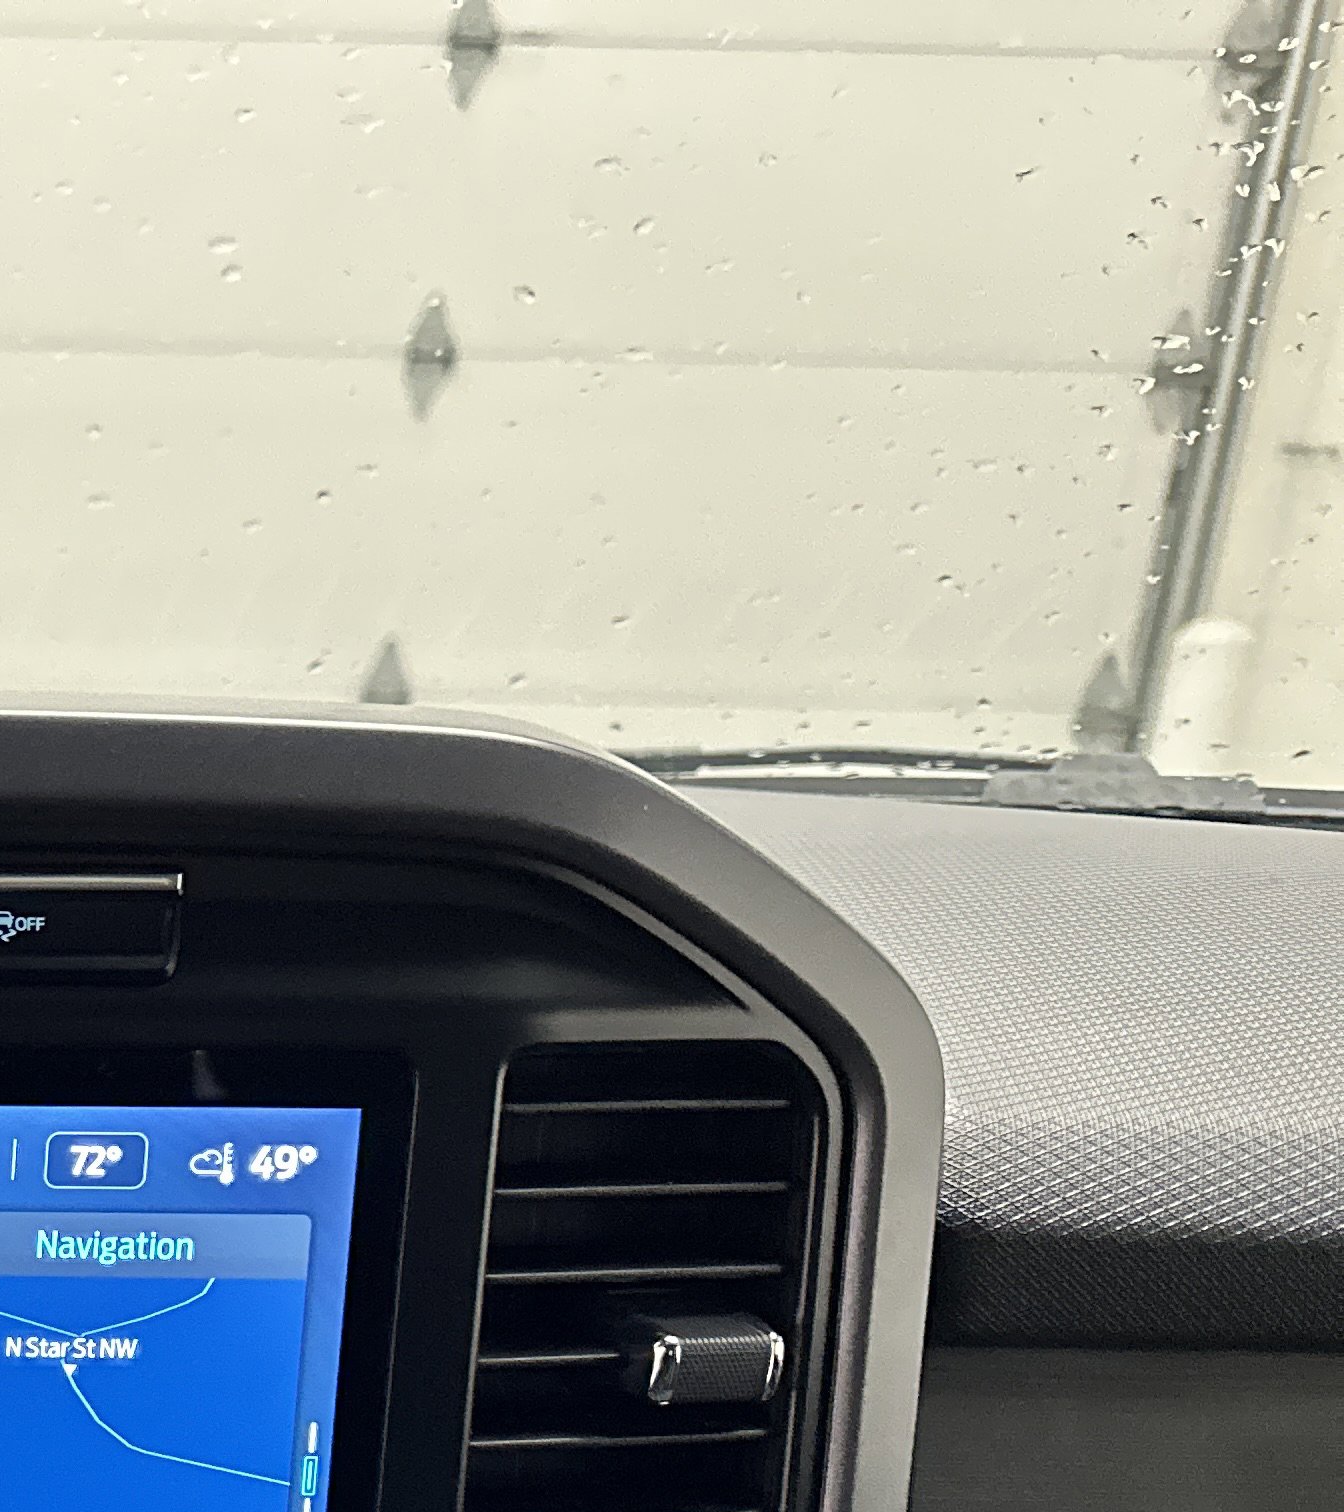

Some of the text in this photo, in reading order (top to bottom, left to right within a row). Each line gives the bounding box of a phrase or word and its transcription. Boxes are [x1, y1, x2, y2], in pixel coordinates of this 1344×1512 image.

[14, 916, 46, 932] OFF
[35, 1229, 195, 1266] Navigation
[5, 1336, 139, 1359] N Star St NW
